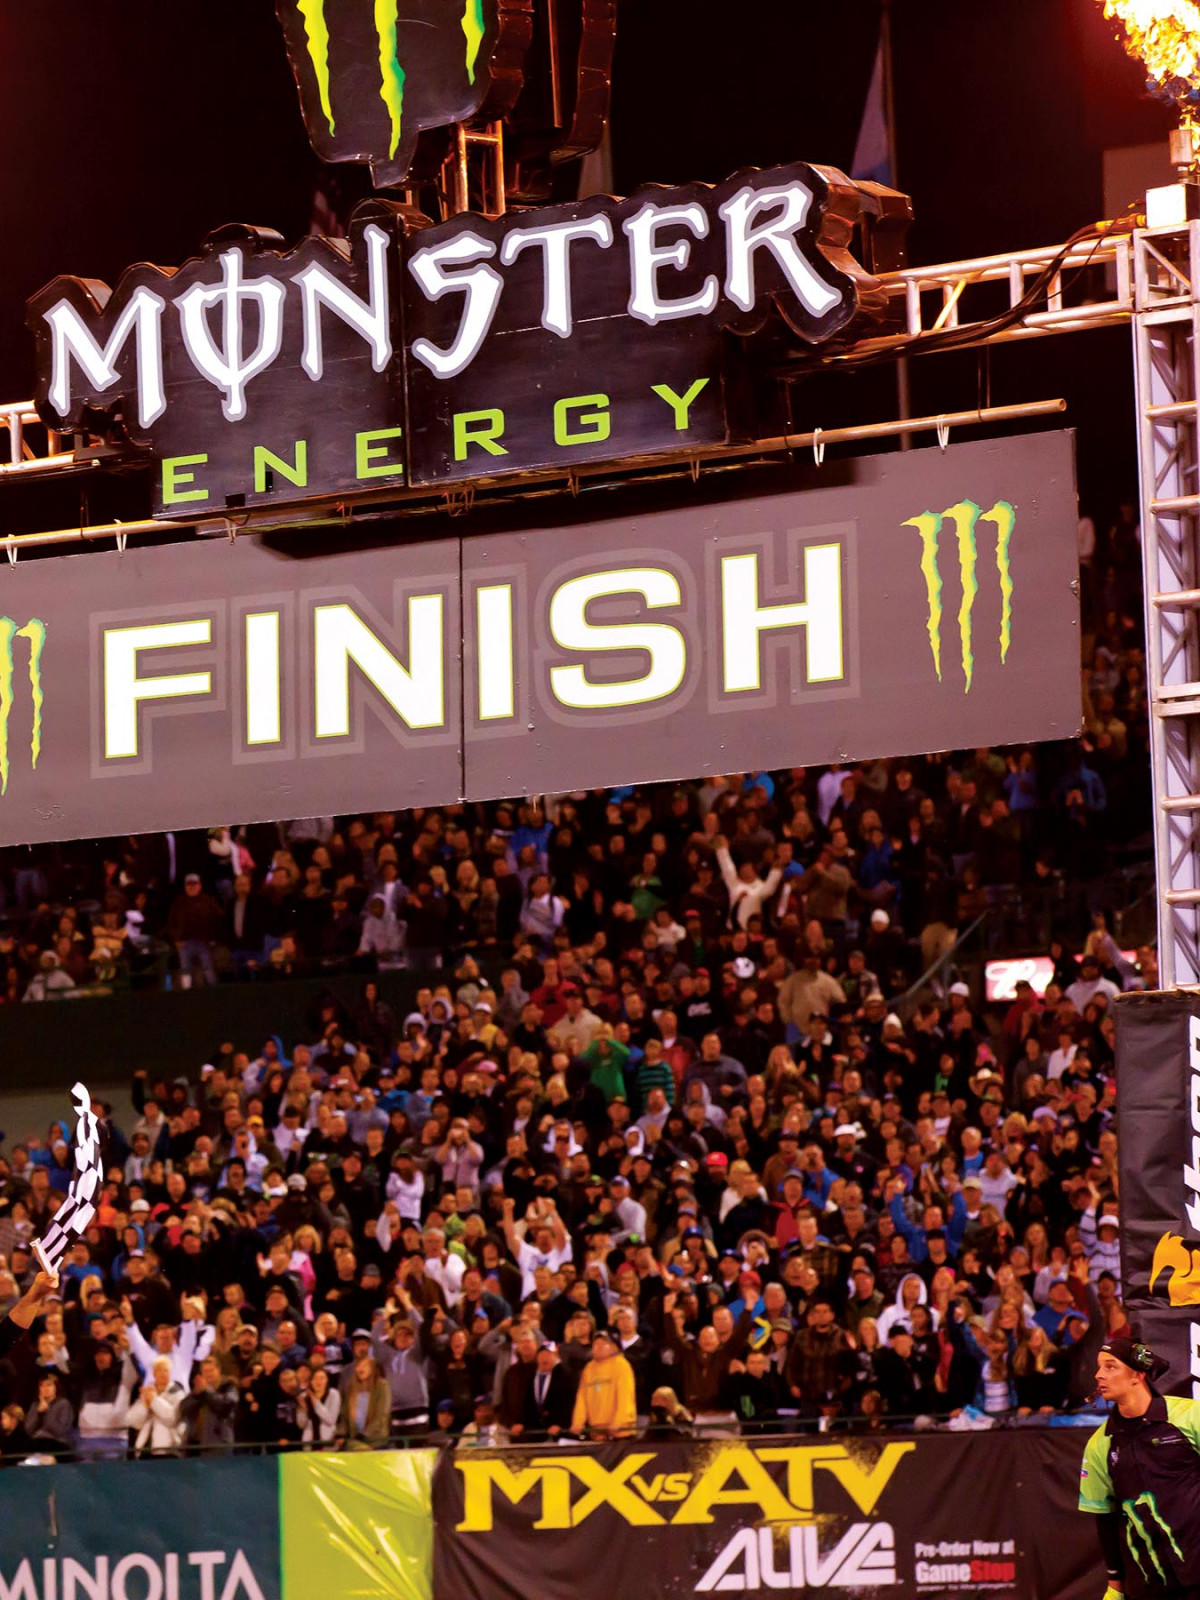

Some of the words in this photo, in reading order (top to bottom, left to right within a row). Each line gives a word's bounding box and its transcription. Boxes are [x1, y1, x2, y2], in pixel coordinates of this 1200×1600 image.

[44, 179, 846, 429] MONSTER
[161, 377, 711, 506] ENERGY
[102, 541, 844, 761] FINISH
[454, 1452, 668, 1532] MX
[670, 1441, 917, 1524] ATV
[694, 1521, 900, 1592] ALIVE
[915, 1559, 1016, 1584] GameStop
